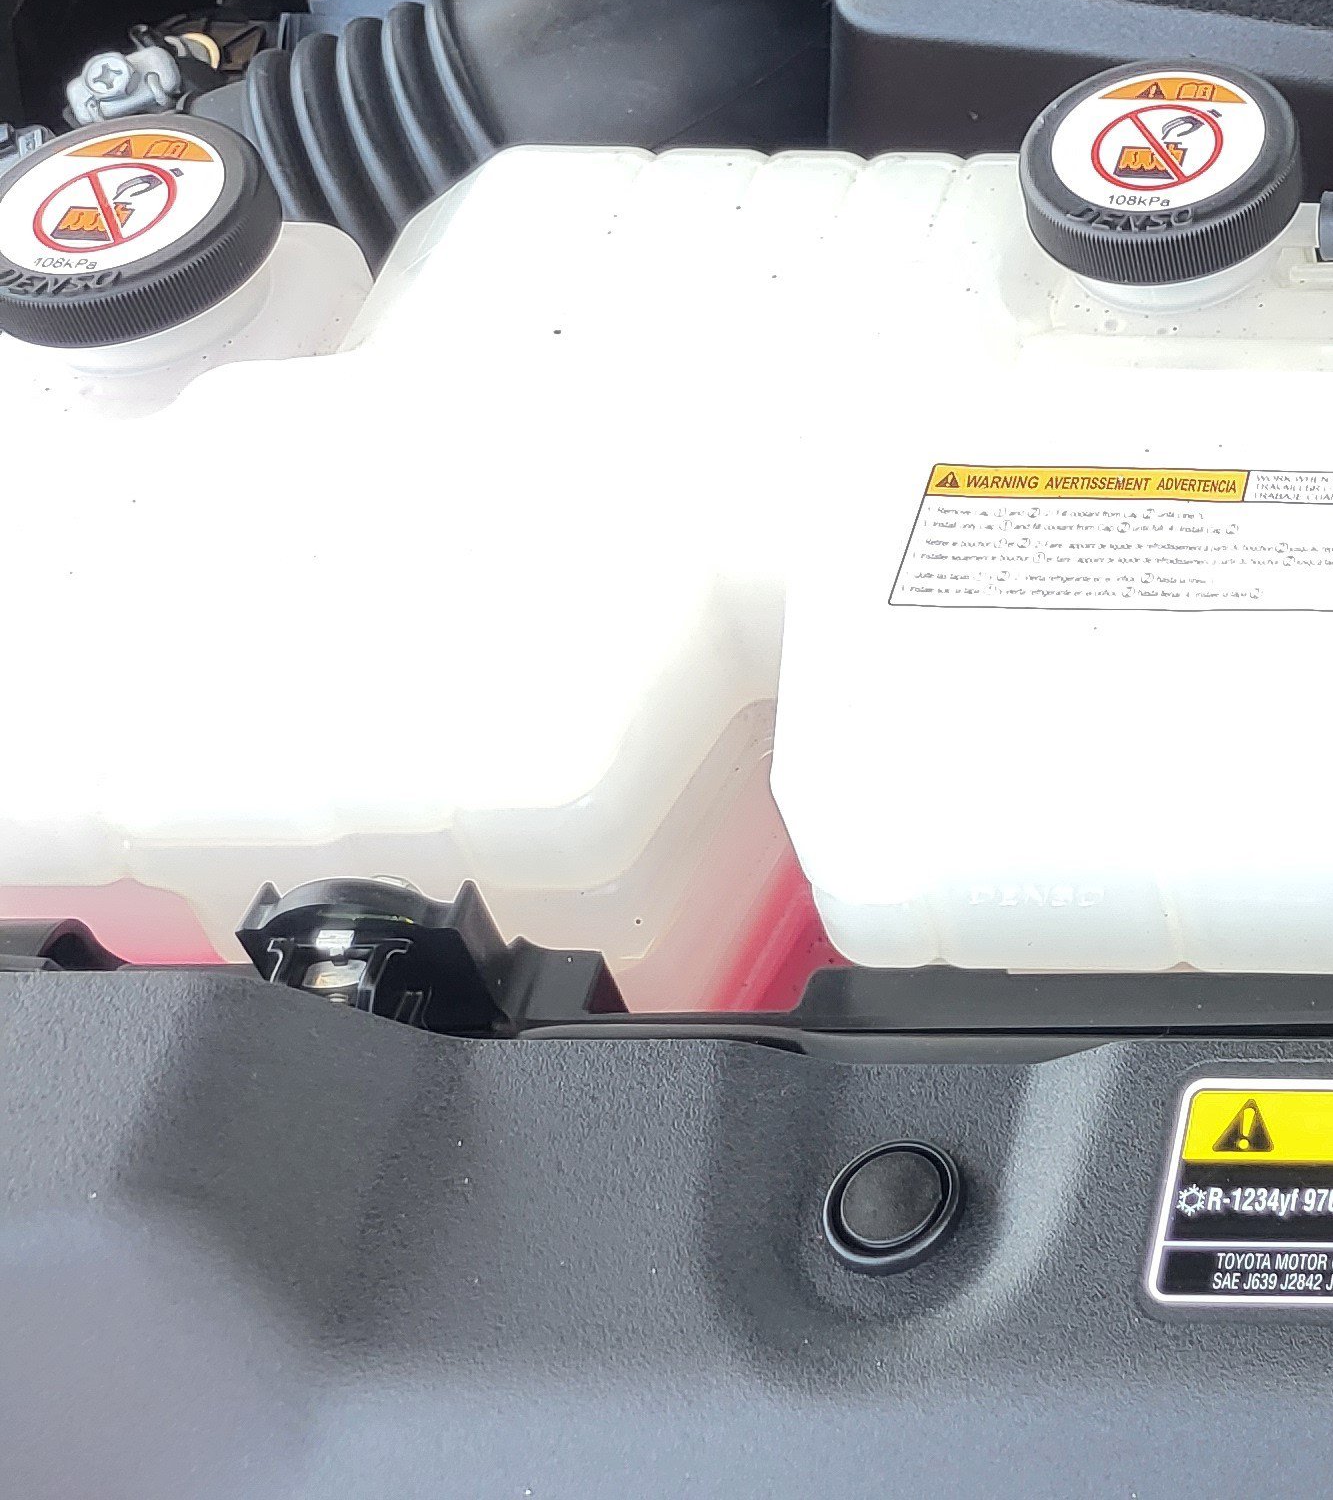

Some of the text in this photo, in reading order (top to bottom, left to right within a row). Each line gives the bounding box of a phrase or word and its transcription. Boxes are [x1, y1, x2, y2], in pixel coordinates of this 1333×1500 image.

[1108, 194, 1171, 207] 108kPa
[1066, 207, 1193, 233] DENSO
[33, 257, 98, 270] 108kPa
[966, 475, 1238, 494] WARNING AVERTISSEMENT ADVERTENCIA
[1206, 1186, 1300, 1215] R-1234yf
[1216, 1252, 1271, 1270] TOYOTA
[1275, 1252, 1327, 1271] MOTOR
[1212, 1273, 1240, 1289] SAE
[1242, 1273, 1278, 1290] J639
[1280, 1273, 1322, 1290] J2842
